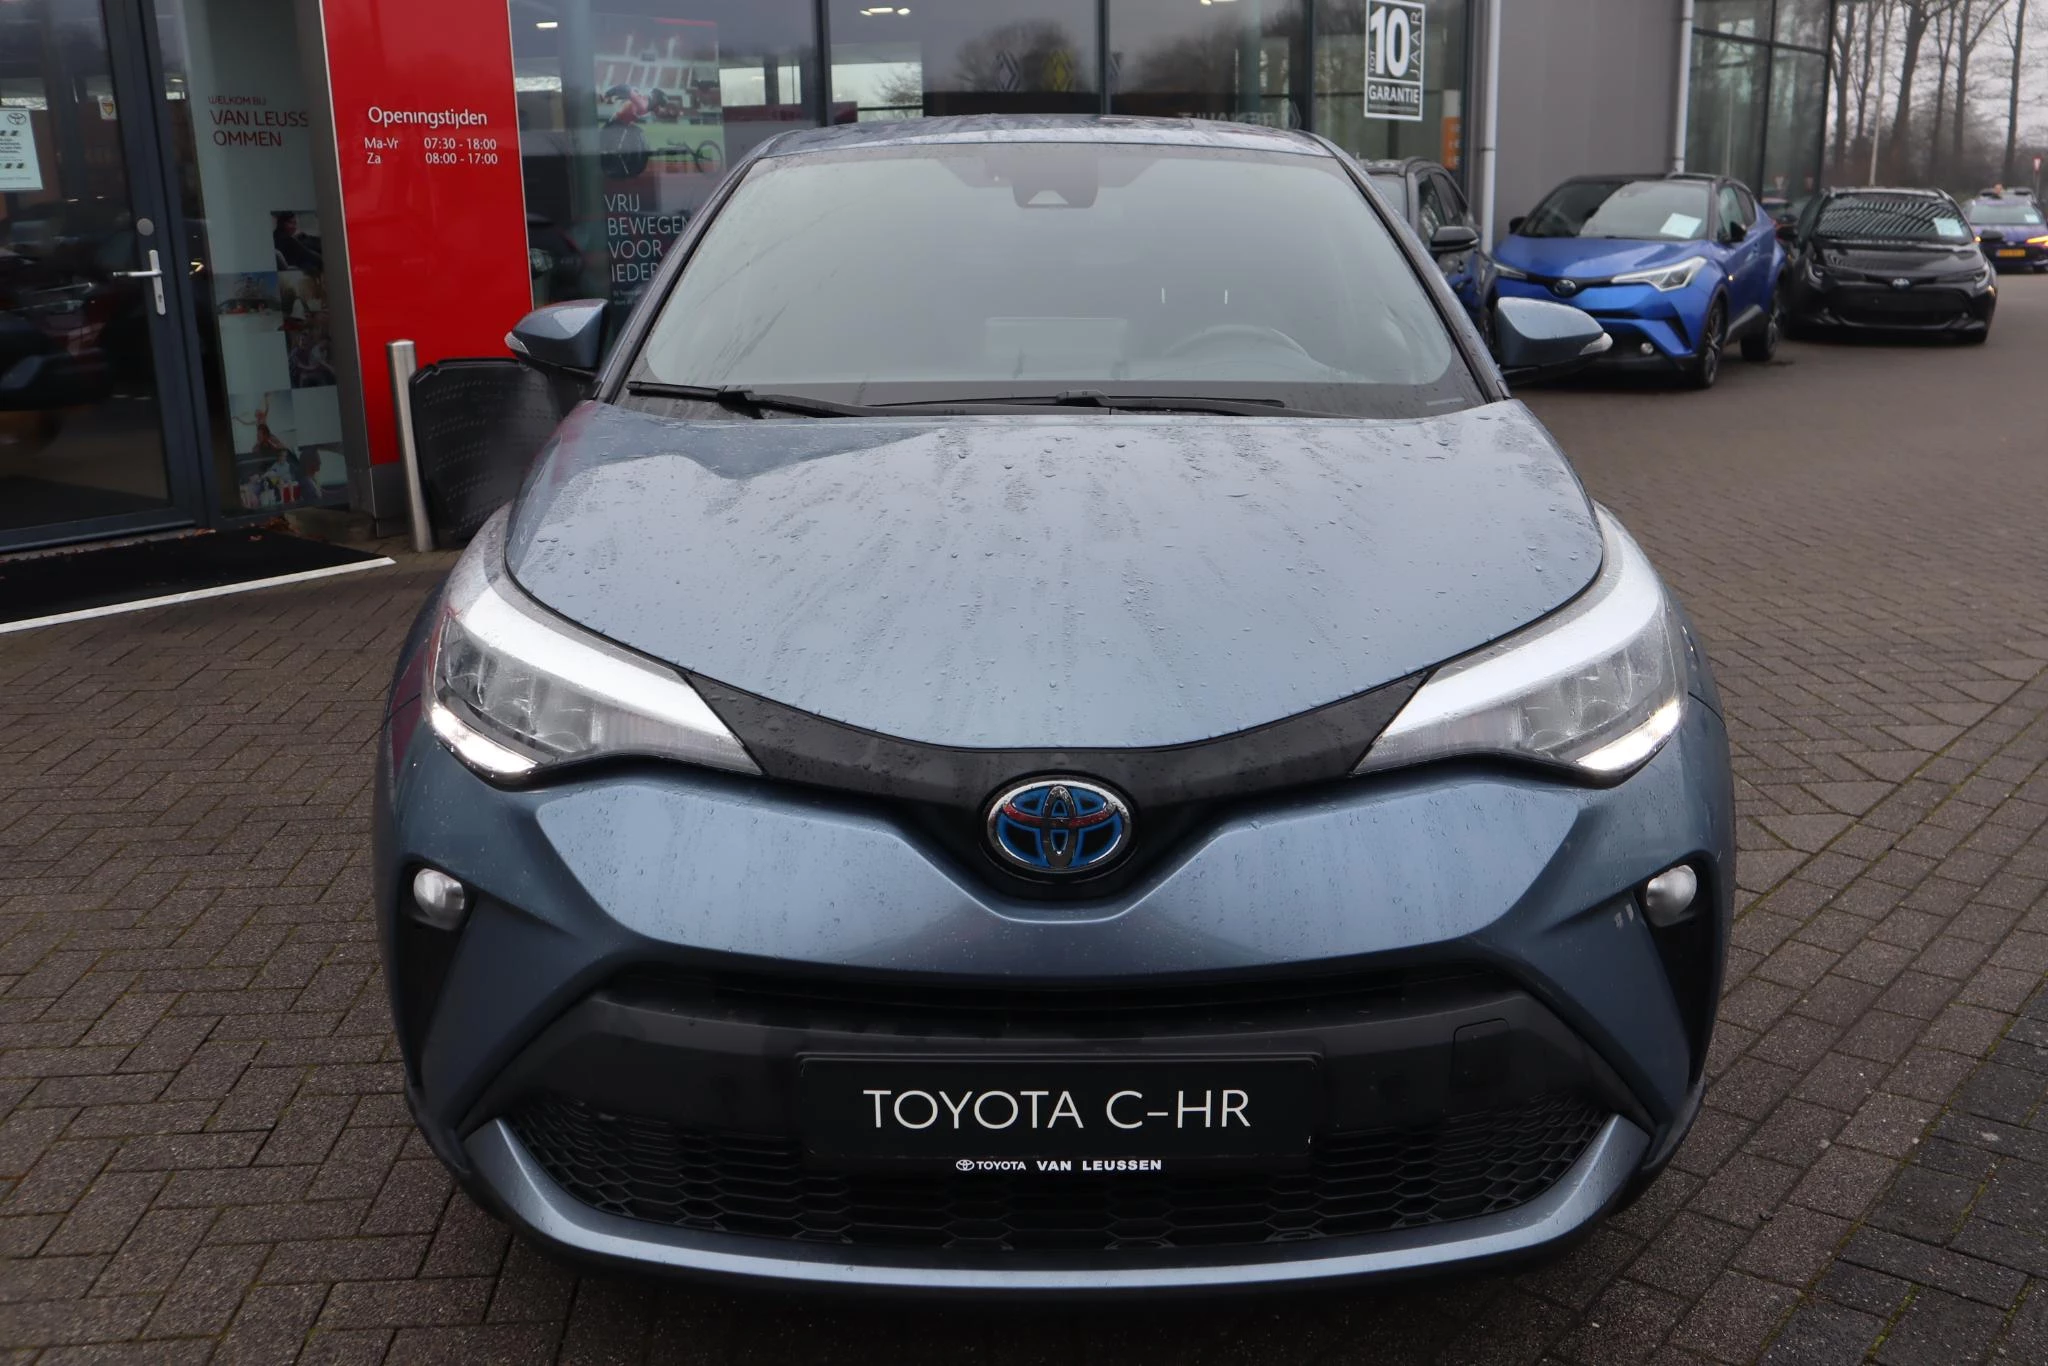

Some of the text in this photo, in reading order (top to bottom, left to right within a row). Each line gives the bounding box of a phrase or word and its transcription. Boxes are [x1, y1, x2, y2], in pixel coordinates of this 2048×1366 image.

[1370, 6, 1410, 77] 10
[1410, 11, 1421, 78] JAAR
[208, 95, 250, 105] WELKOM
[1368, 85, 1420, 103] GARANTIE
[210, 110, 249, 125] VAN
[368, 106, 488, 129] Openingstijden
[213, 130, 282, 146] OMMEN
[364, 137, 398, 149] Ma-Vr
[424, 137, 456, 149] 07:30
[467, 138, 497, 150] 18:00
[367, 152, 381, 164] Za
[425, 153, 457, 164] 08:00
[468, 153, 498, 165] 17:00
[604, 193, 640, 212] VRIJ
[607, 239, 663, 259] VOOR
[863, 1090, 1251, 1129] TOYOTA C-HR
[976, 1159, 1162, 1171] TOYOTA VAN LEUSSEN
